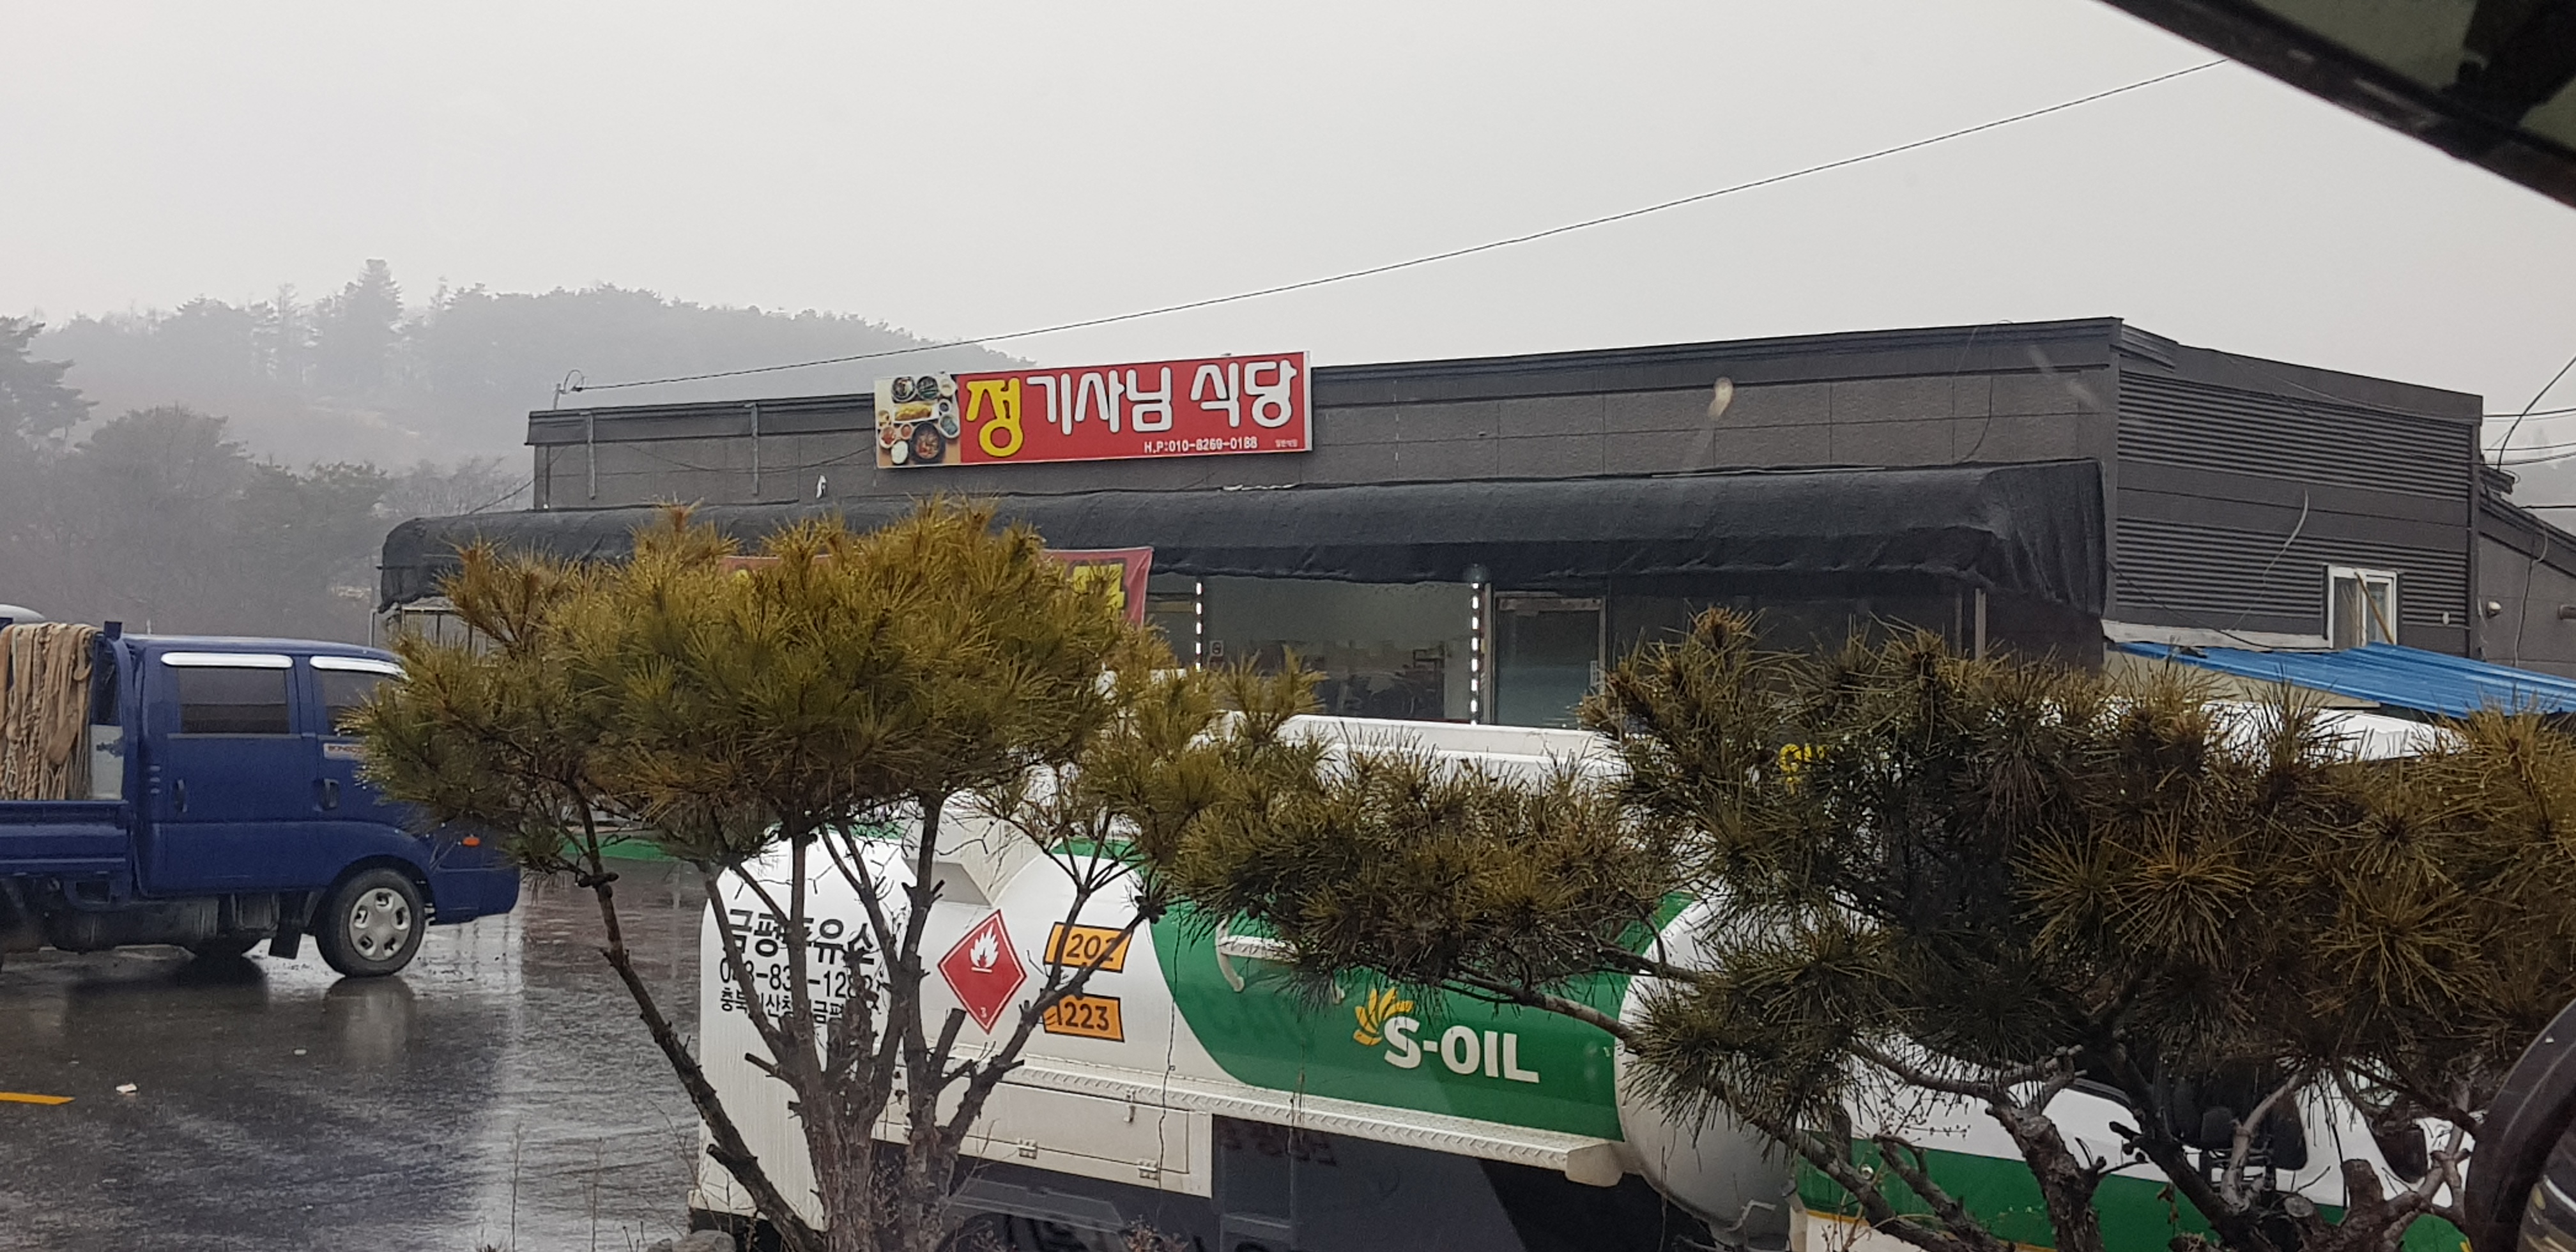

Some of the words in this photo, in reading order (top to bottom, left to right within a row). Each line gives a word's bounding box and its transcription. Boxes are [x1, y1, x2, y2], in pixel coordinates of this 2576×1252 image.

[1190, 359, 1298, 430] 식당
[979, 1007, 987, 1019] 3
[1057, 1001, 1110, 1032] 1223
[1383, 1016, 1540, 1083] S-OIL
